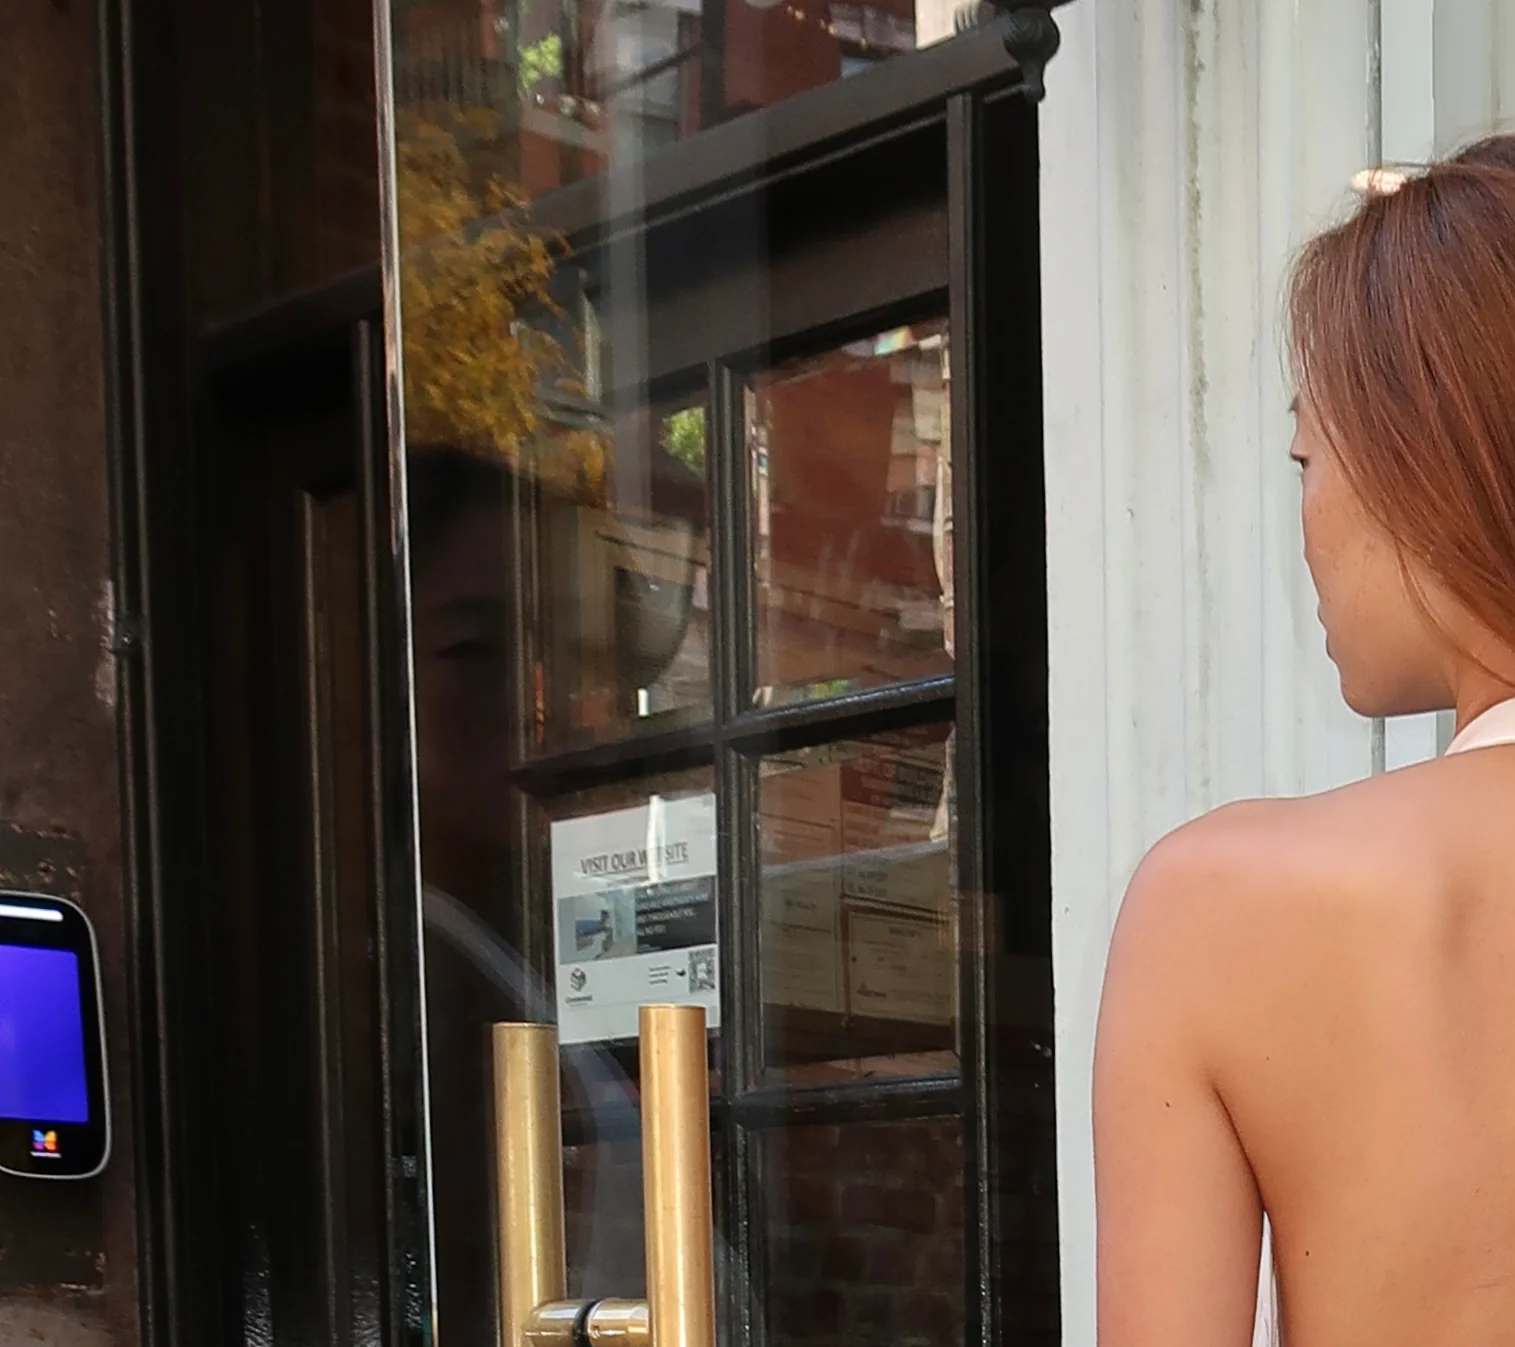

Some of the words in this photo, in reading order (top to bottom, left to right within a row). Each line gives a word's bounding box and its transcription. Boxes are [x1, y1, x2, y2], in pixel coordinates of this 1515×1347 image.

[580, 854, 609, 875] VISIT
[611, 850, 636, 870] OUR
[637, 842, 689, 866] WSITE
